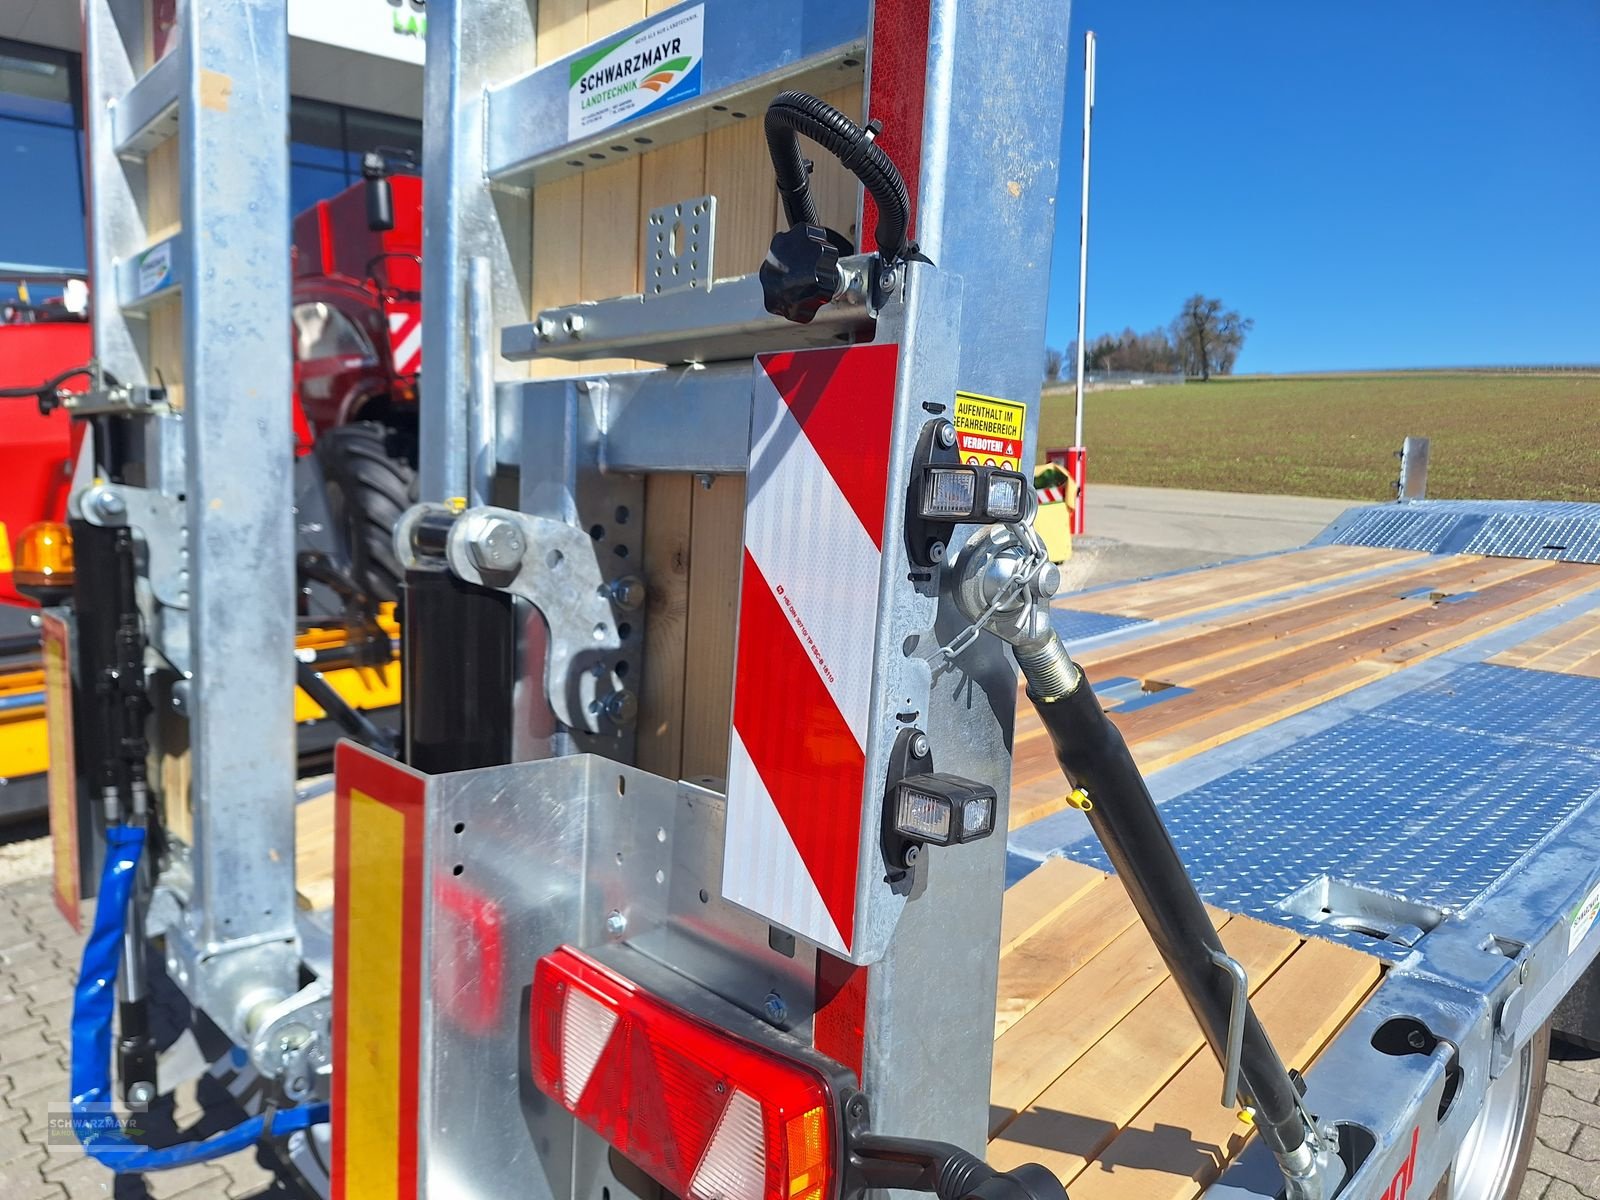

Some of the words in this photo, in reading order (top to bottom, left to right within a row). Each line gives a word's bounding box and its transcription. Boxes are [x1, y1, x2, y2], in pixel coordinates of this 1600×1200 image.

[580, 38, 681, 94] SCHWARZMAYR
[581, 80, 638, 110] LANDTECHNIK
[958, 402, 1003, 421] AUFENTHALT
[1004, 410, 1013, 423] IM
[963, 435, 1003, 453] VERBOTEN!
